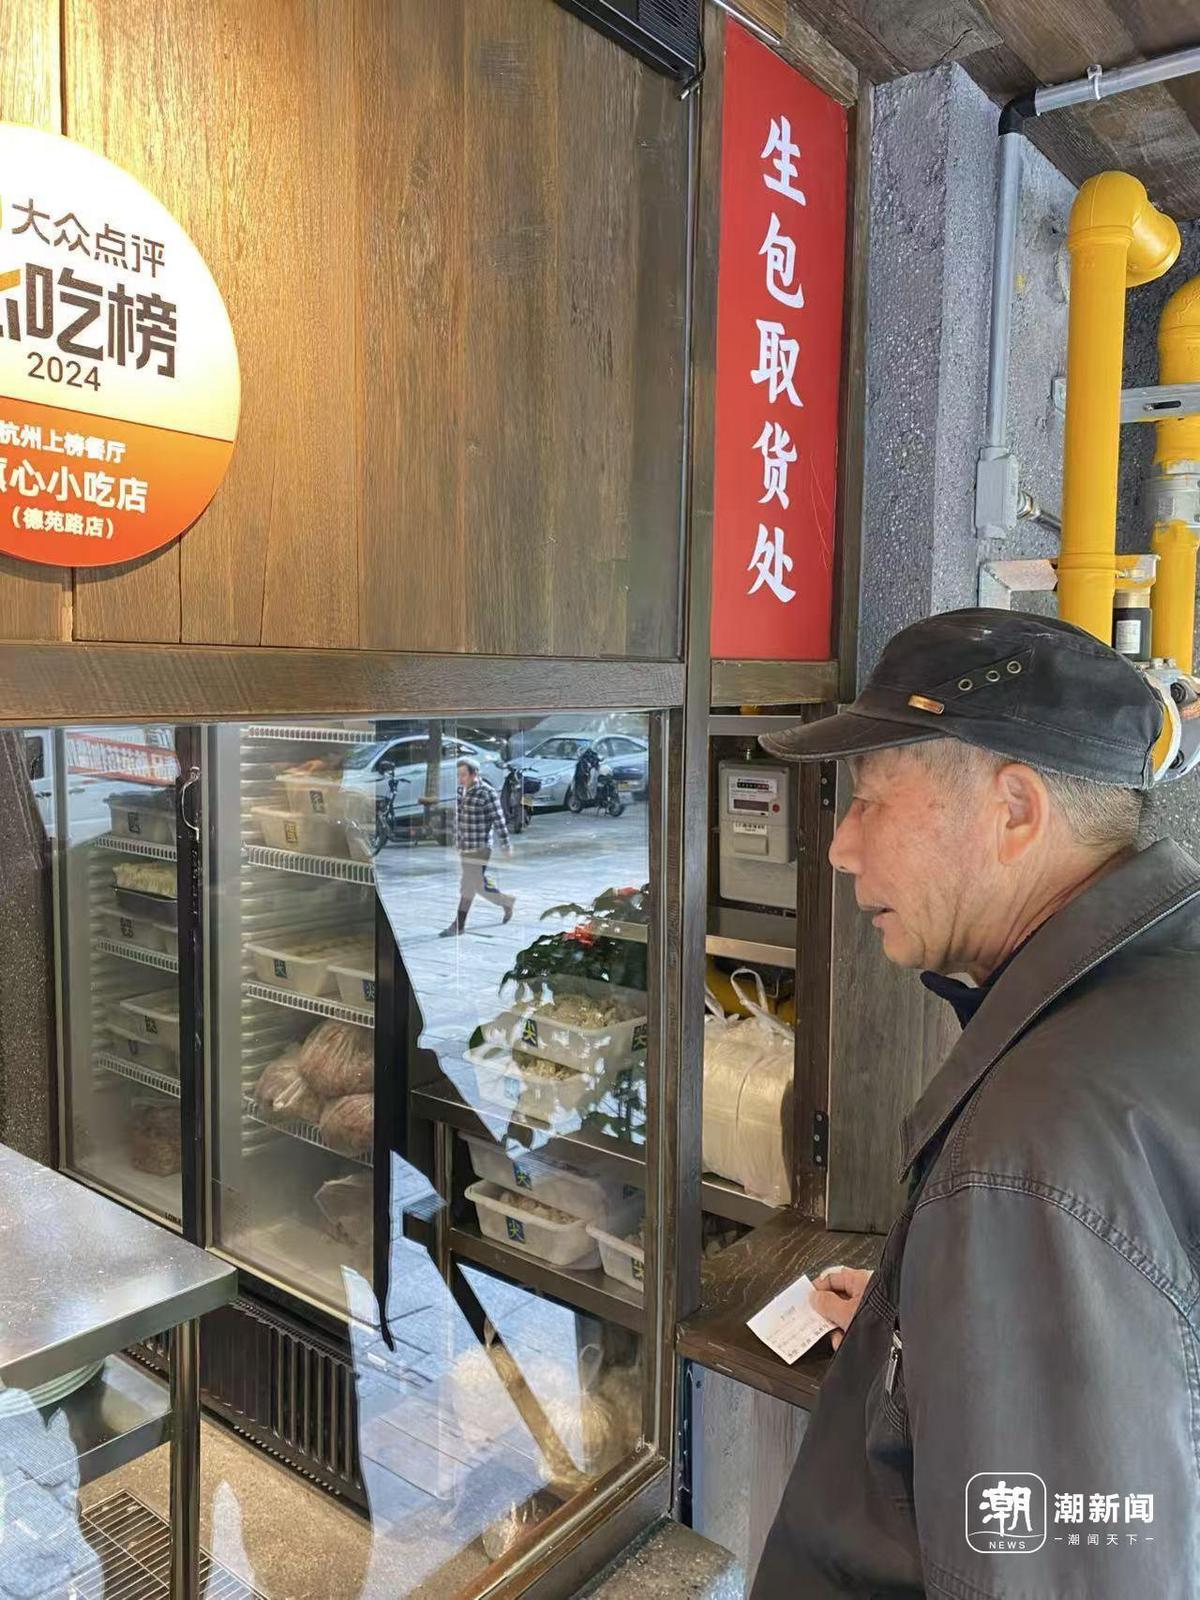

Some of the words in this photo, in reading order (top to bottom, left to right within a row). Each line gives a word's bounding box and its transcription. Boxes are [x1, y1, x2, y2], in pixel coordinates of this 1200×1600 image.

[12, 198, 165, 278] 大众点评
[27, 351, 101, 391] 2024
[747, 115, 806, 603] 生包取货处
